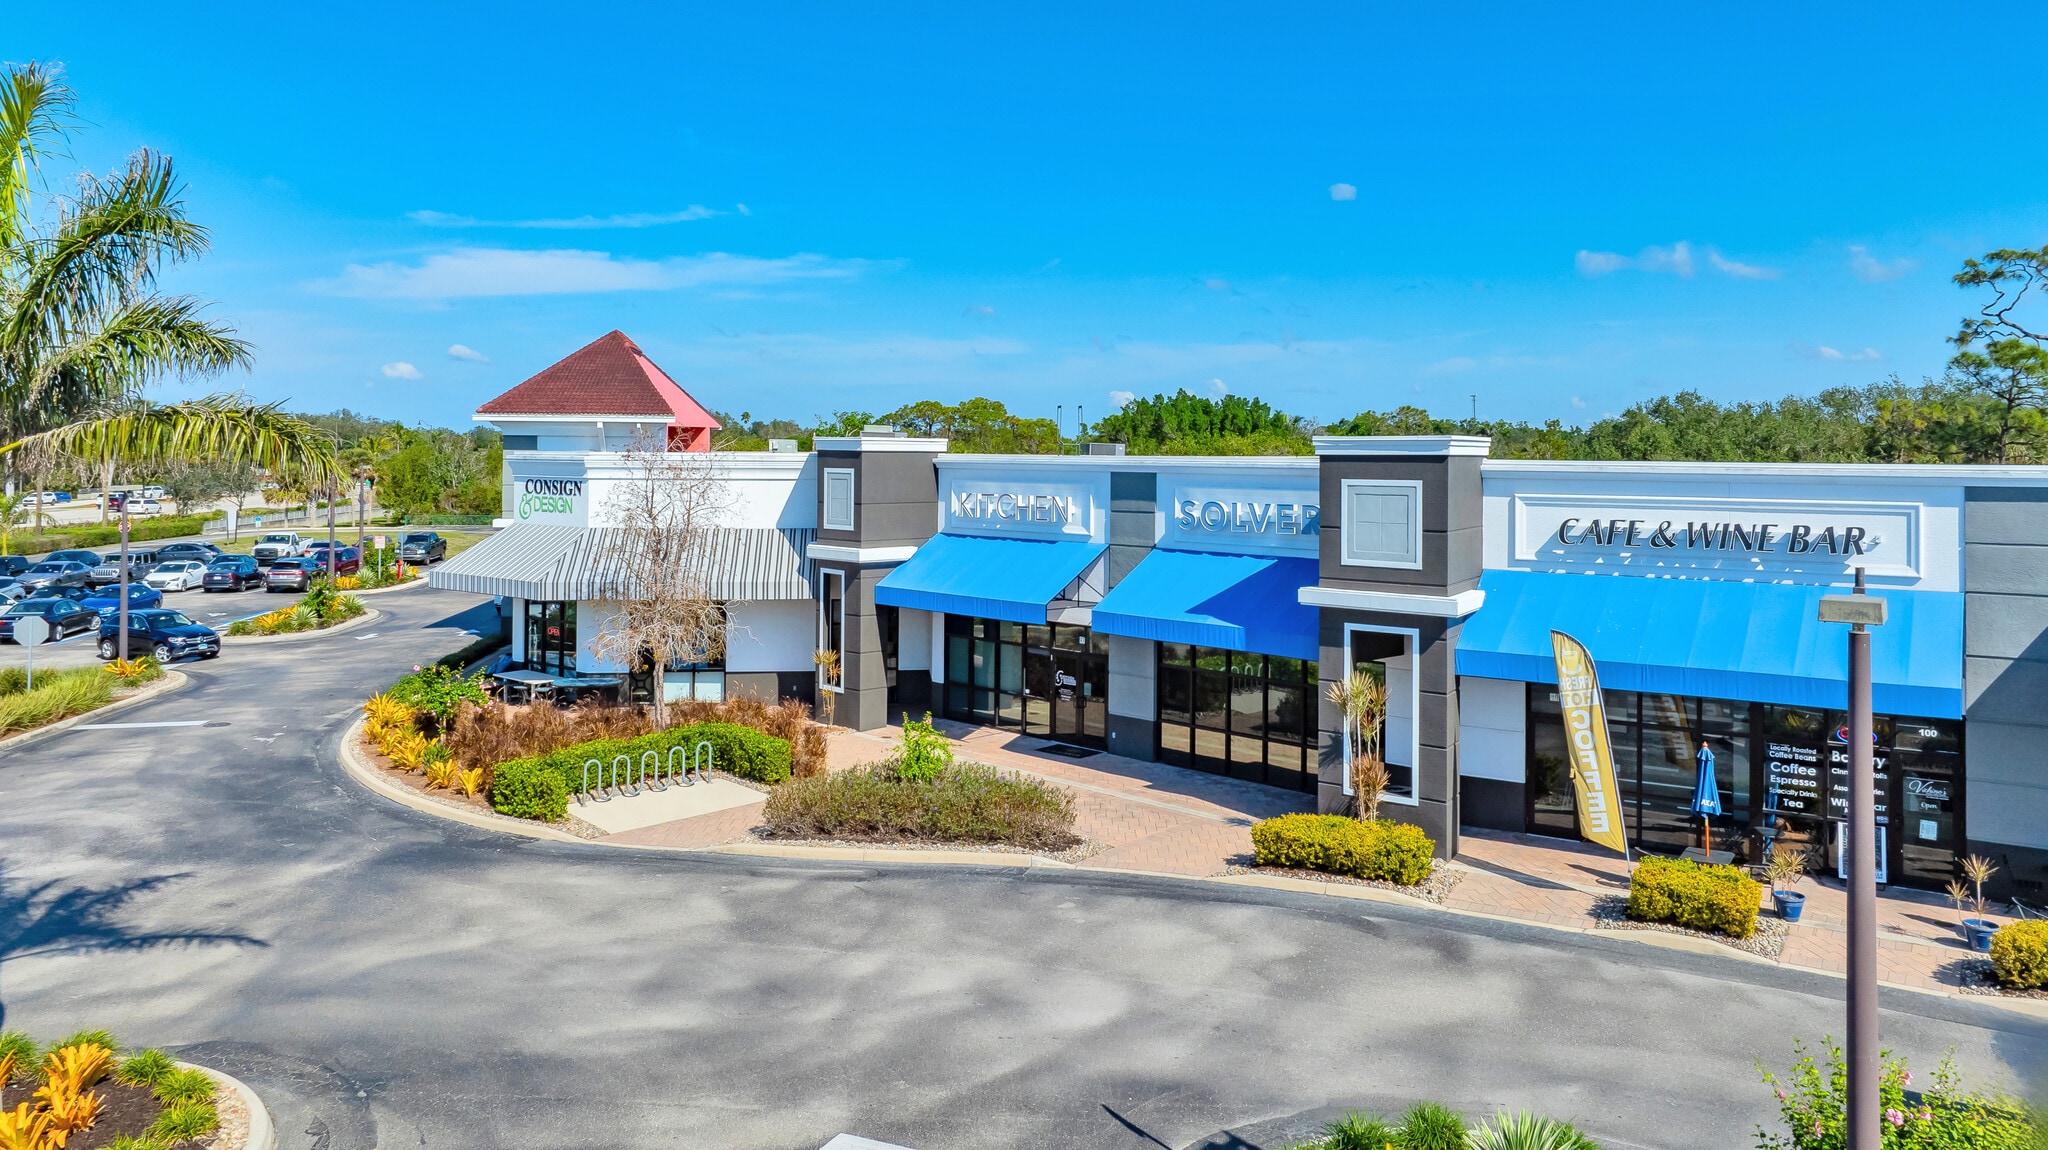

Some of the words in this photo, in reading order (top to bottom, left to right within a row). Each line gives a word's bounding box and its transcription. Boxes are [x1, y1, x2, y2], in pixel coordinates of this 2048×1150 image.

[525, 479, 583, 496] CONSIGN
[519, 493, 534, 520] &
[533, 496, 573, 514] DESIGN
[959, 492, 1073, 523] KITCHEN
[1178, 500, 1320, 535] SOLVER
[1558, 518, 1645, 547] CAFE
[1650, 520, 1677, 549] &
[1686, 522, 1778, 553] WINE
[1787, 525, 1866, 555] BAR
[1919, 729, 1937, 737] 100
[1769, 751, 1793, 759] Coffee
[1770, 762, 1817, 776] Coffee
[1770, 775, 1817, 787] Espresso
[1783, 798, 1804, 808] Tea
